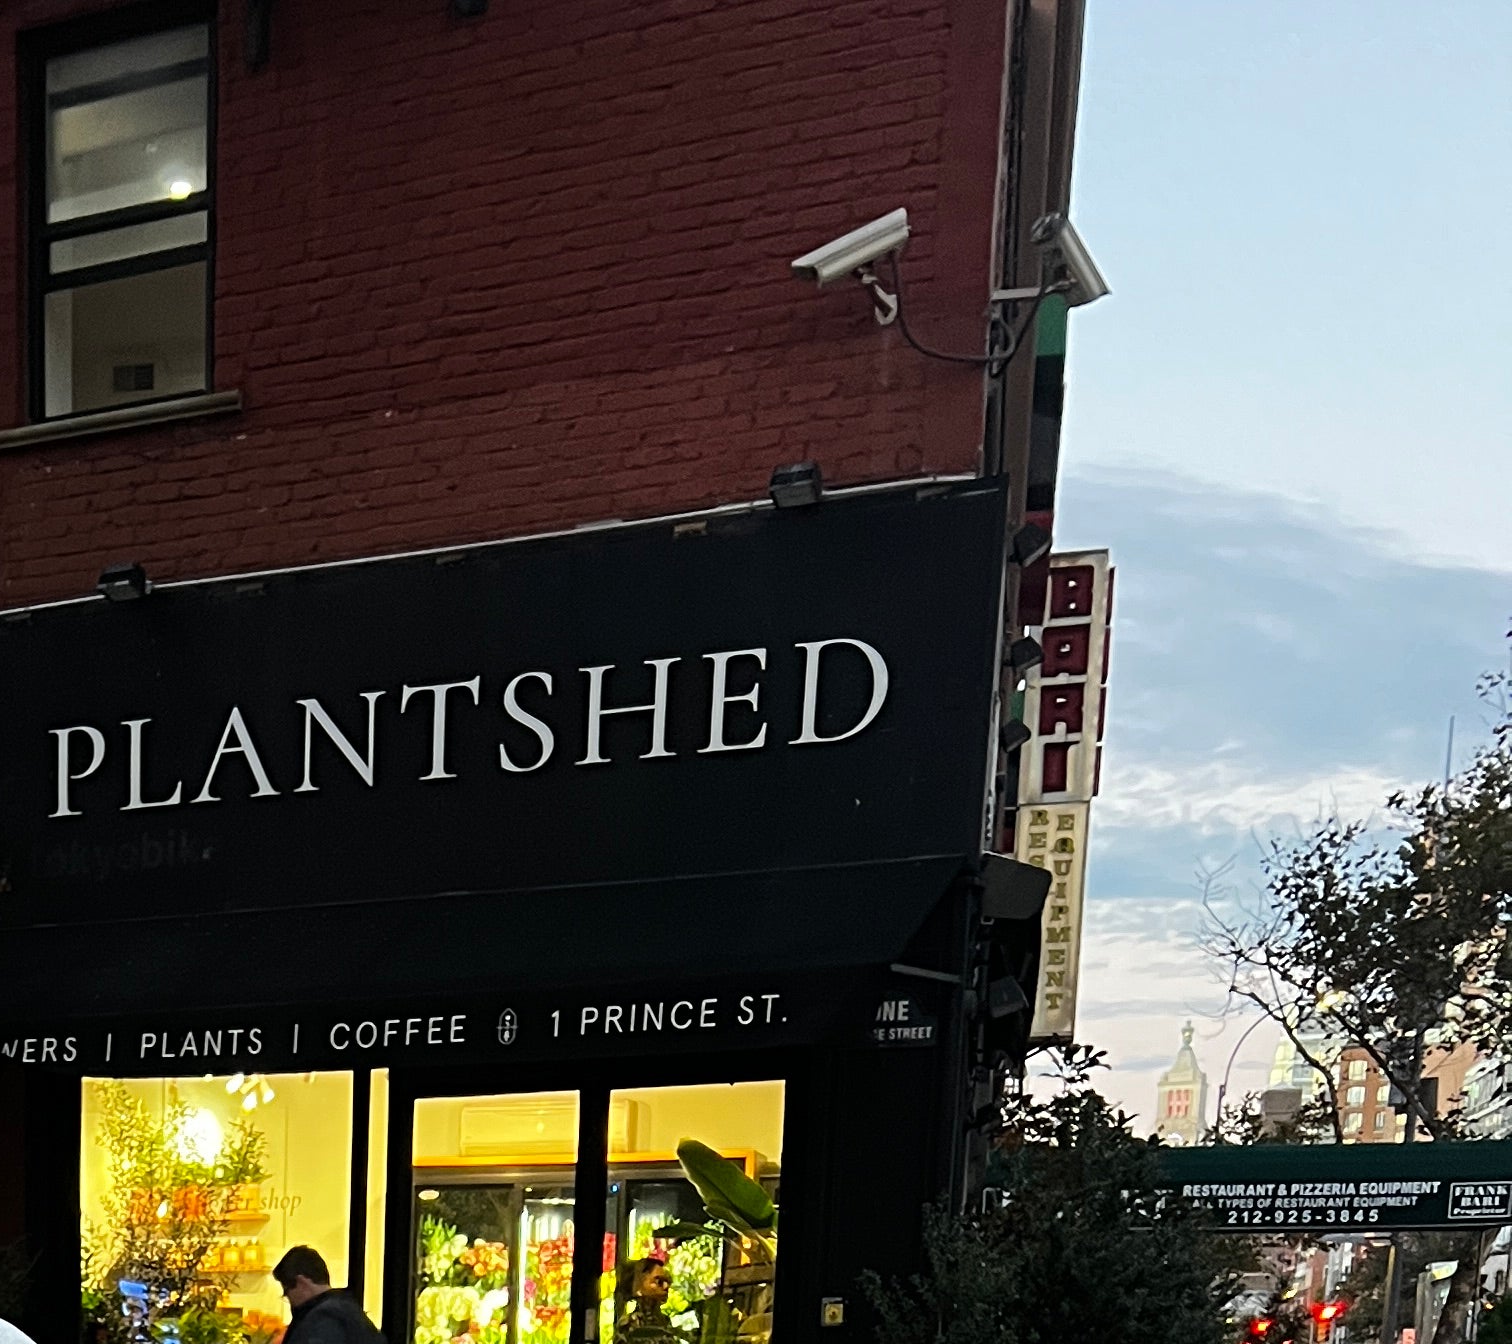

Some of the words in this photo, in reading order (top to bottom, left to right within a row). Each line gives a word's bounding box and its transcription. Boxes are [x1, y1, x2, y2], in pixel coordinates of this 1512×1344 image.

[1039, 565, 1095, 794] BARI
[48, 637, 890, 818] PLANTSHED
[1045, 814, 1076, 1010] EQUIPMENT
[140, 1028, 263, 1059] PLANTS
[329, 1014, 467, 1050] COFFEE
[550, 1010, 561, 1038] 1
[579, 997, 718, 1036] PRINCE
[737, 993, 789, 1025] ST.
[888, 1026, 933, 1040] STREET
[1182, 1184, 1276, 1197] RESTAURANT
[1277, 1183, 1288, 1196] &
[1290, 1183, 1356, 1196] PIZZERIA
[1359, 1181, 1442, 1195] EQUIPMENT
[1454, 1185, 1509, 1197] FRANK
[260, 1188, 303, 1216] shop
[1218, 1198, 1254, 1209] TYPES
[1256, 1198, 1272, 1208] OF
[1274, 1197, 1351, 1209] RESTAURANT
[1353, 1196, 1419, 1208] EQUIPMENT
[1460, 1196, 1500, 1207] BARI
[1227, 1208, 1379, 1224] 212-925-3845
